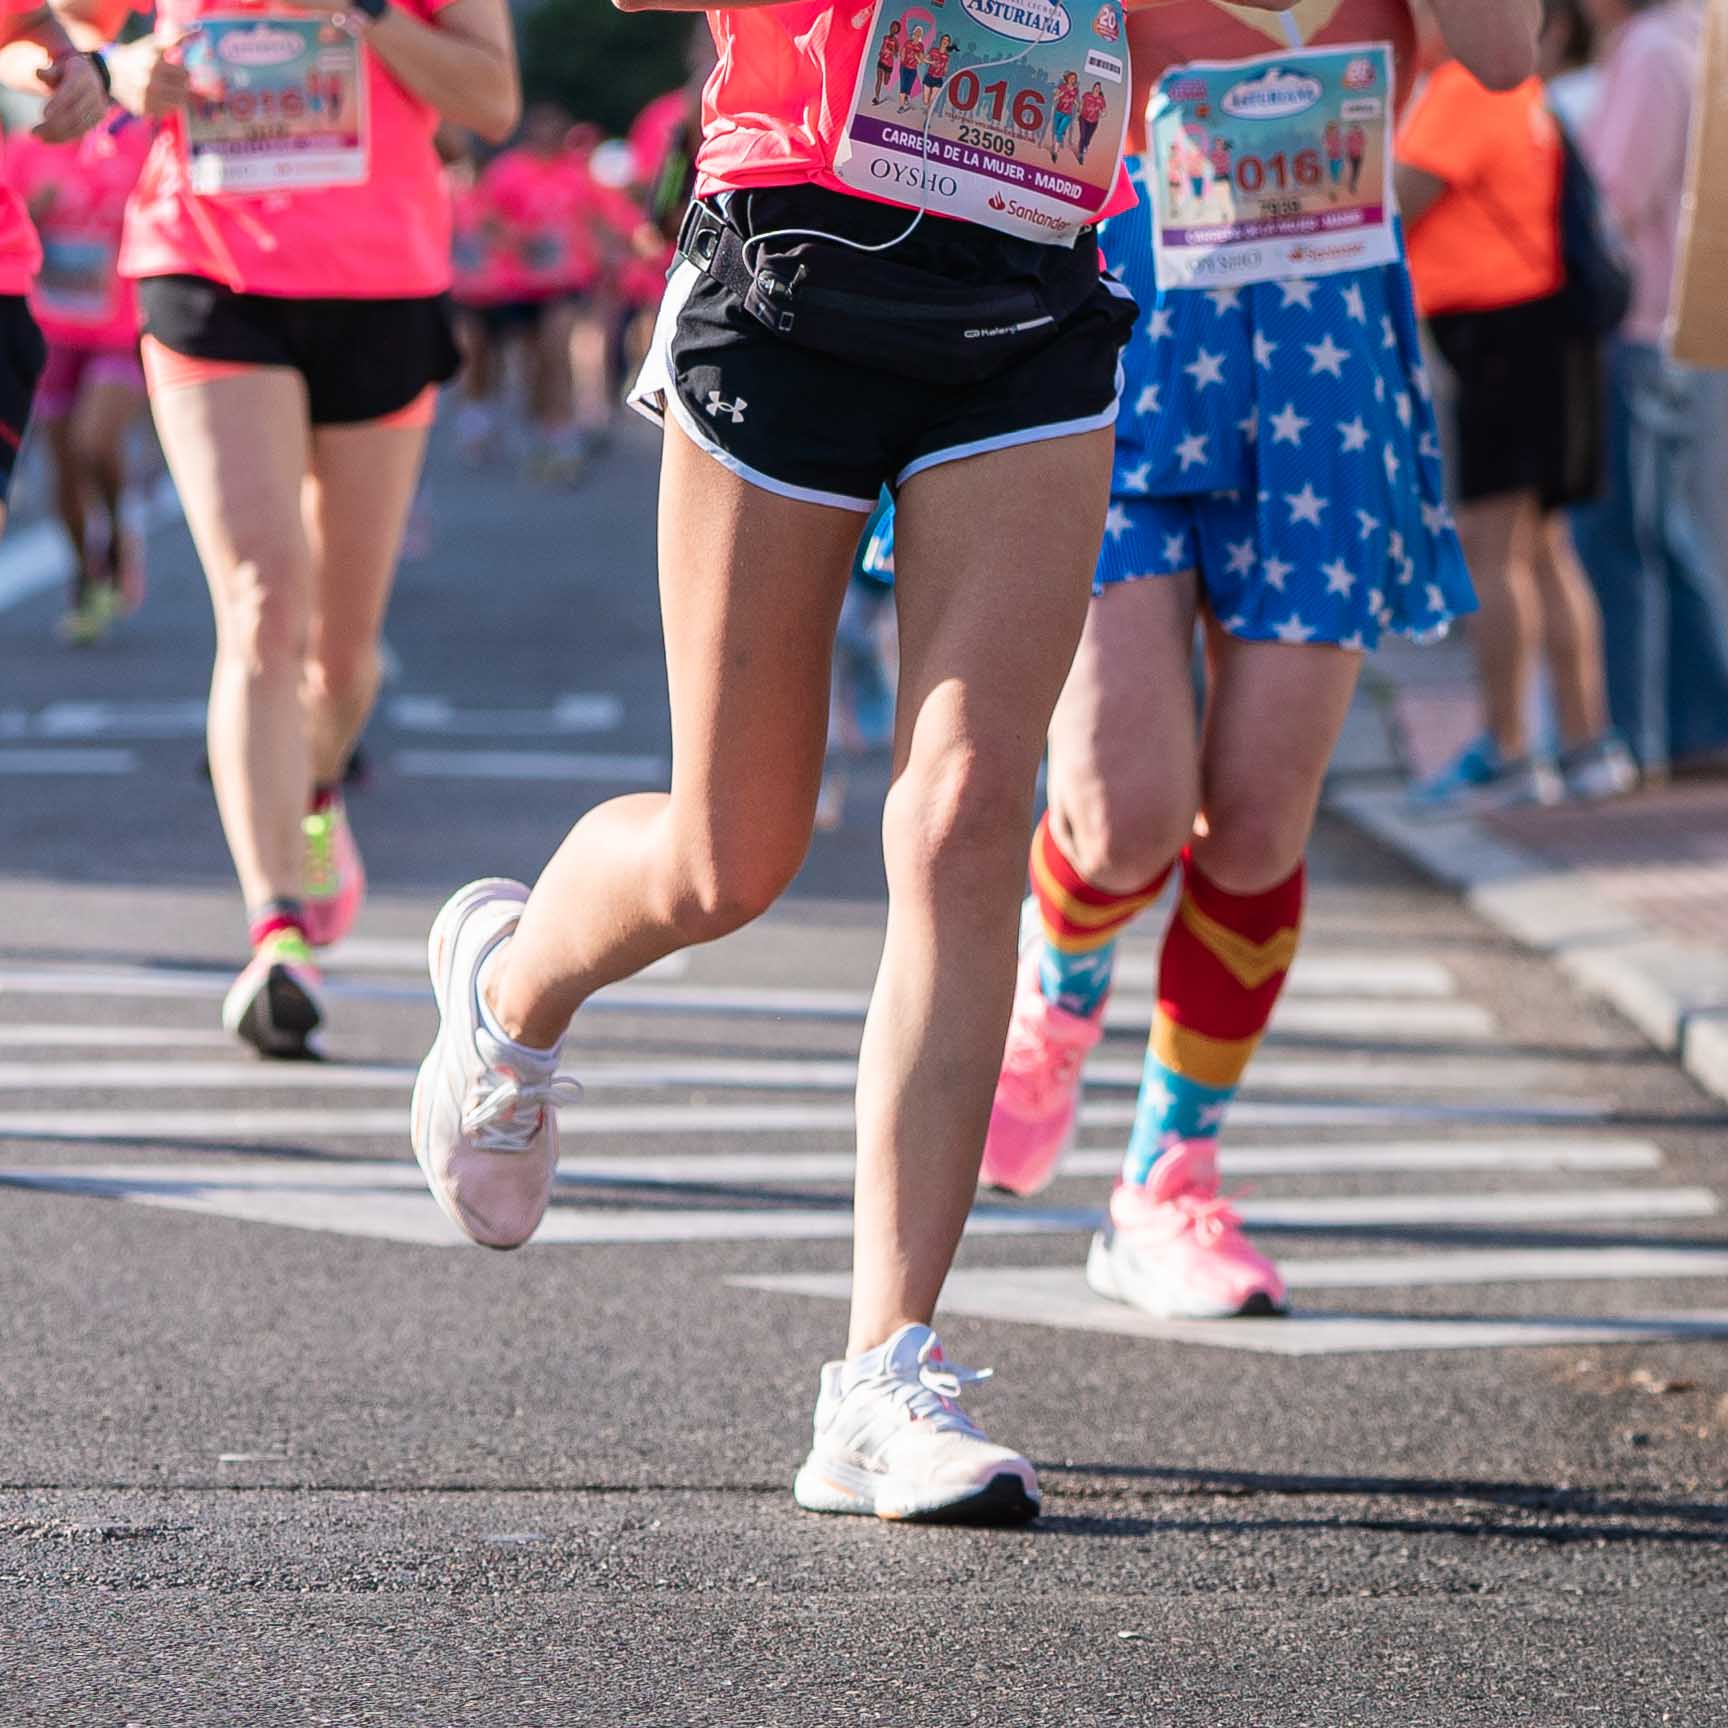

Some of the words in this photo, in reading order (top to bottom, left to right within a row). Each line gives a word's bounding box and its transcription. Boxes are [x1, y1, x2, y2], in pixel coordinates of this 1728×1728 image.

[1099, 7, 1117, 30] 20
[947, 70, 1046, 132] 016
[959, 124, 1015, 157] 23509
[870, 157, 958, 198] OYSHO
[881, 127, 939, 156] CARRERA
[943, 146, 959, 160] DE
[962, 150, 980, 167] LA
[982, 155, 1025, 181] MUJER
[1034, 171, 1082, 201] MADRID
[1235, 149, 1322, 192] 016
[1007, 198, 1071, 232] Santander
